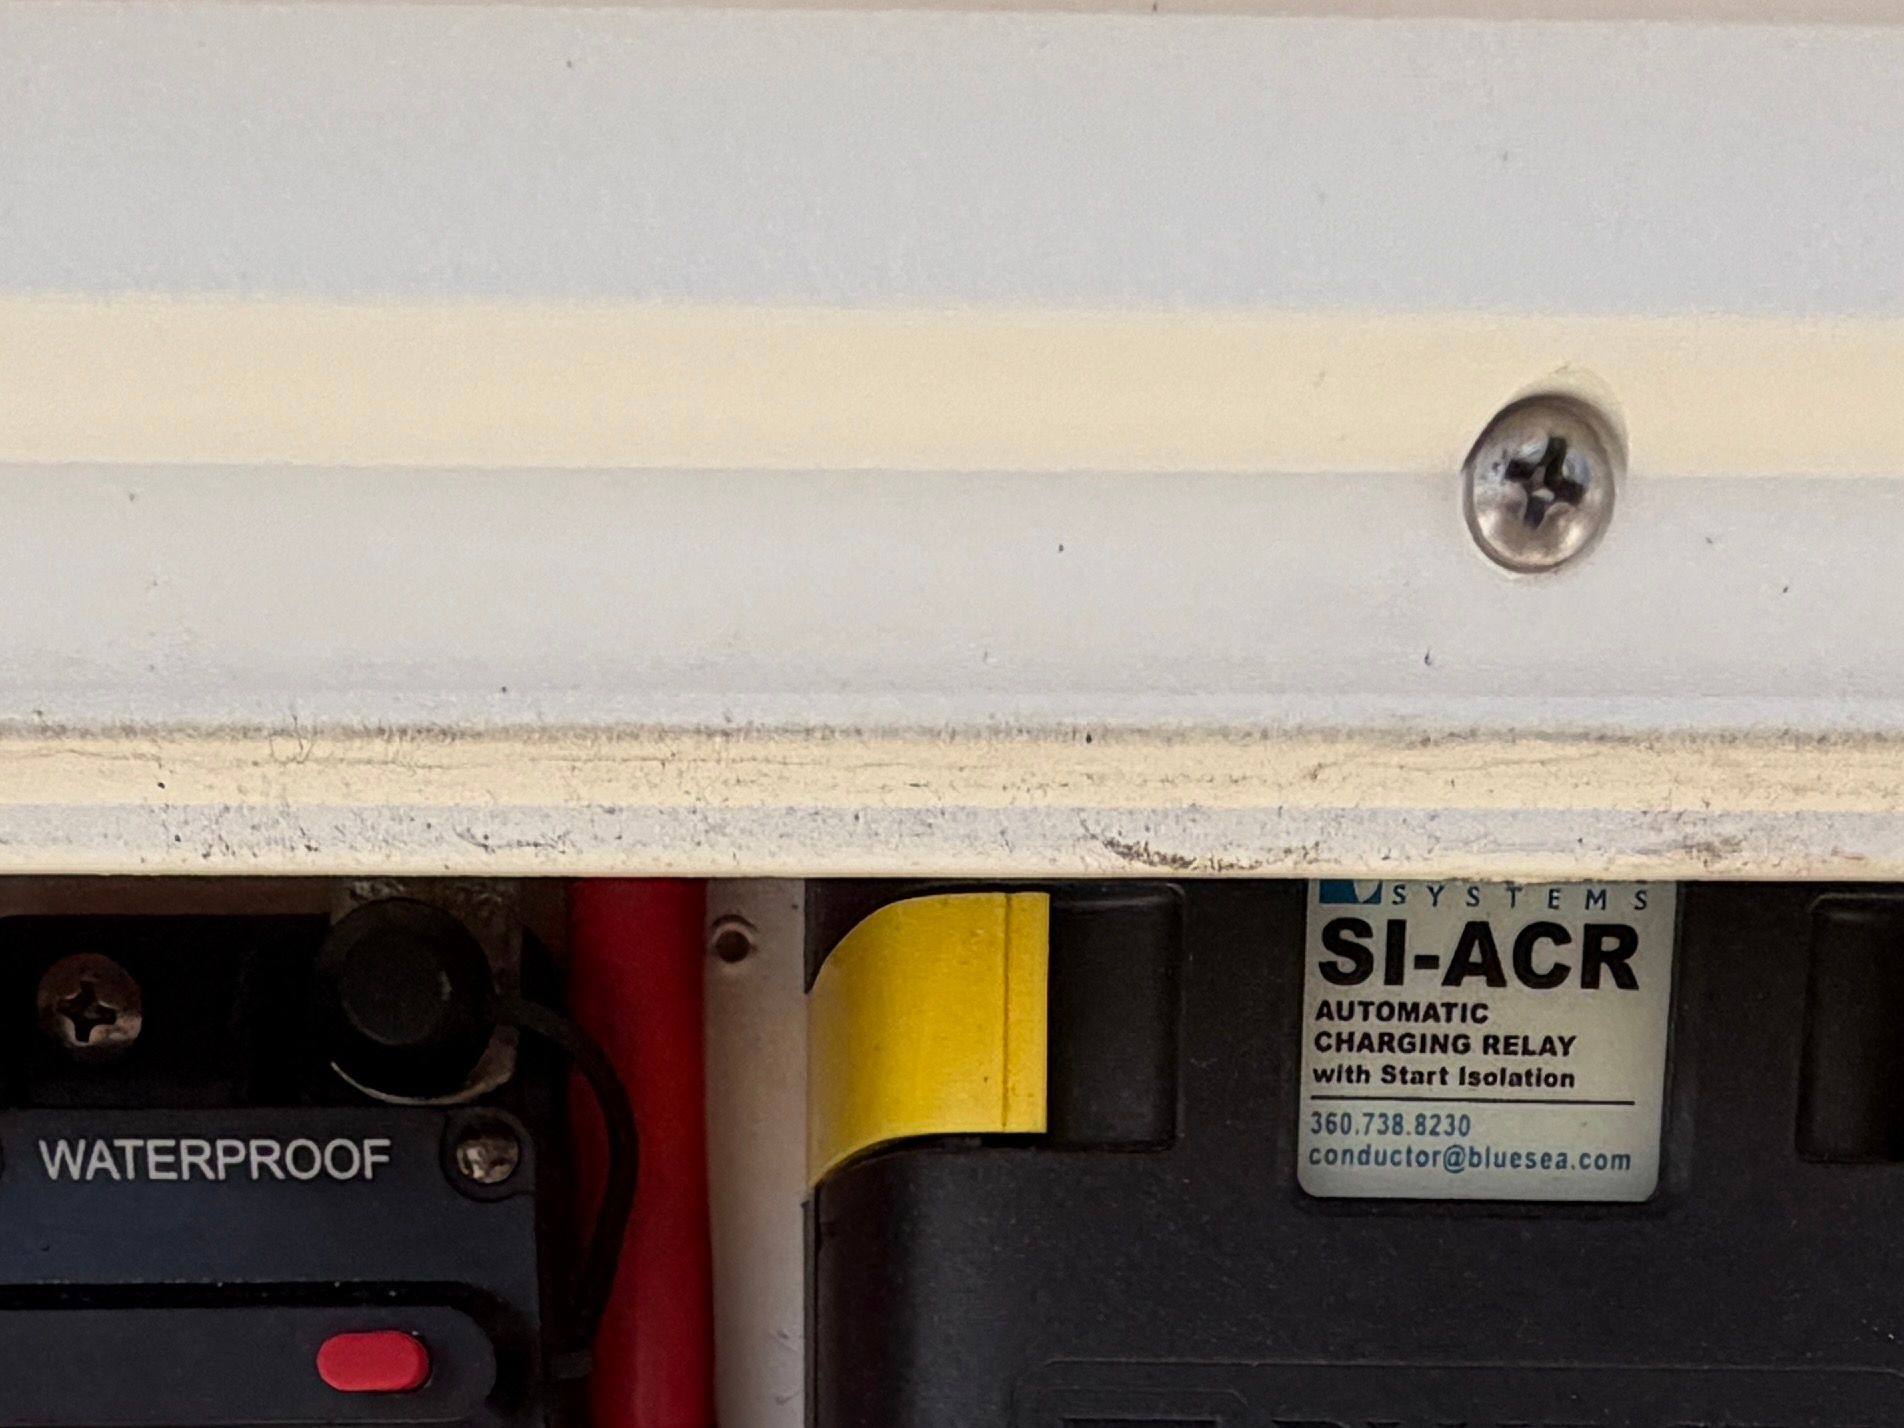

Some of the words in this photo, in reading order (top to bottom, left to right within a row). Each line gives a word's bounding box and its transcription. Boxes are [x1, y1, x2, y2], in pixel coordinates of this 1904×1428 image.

[1392, 884, 1649, 911] SYSTEMS
[1318, 917, 1639, 990] SI-ACR
[1314, 1000, 1491, 1024] AUTOMATIC
[1314, 1031, 1472, 1055] CHARGING
[1482, 1034, 1577, 1057] RELAY
[1312, 1063, 1371, 1084] with
[1381, 1064, 1449, 1086] Start
[1459, 1067, 1576, 1088] Isolation
[1310, 1111, 1472, 1138] 360.738.8230
[39, 1138, 391, 1181] WATERPROOF
[1309, 1144, 1632, 1174] conductor@bluesea.com
